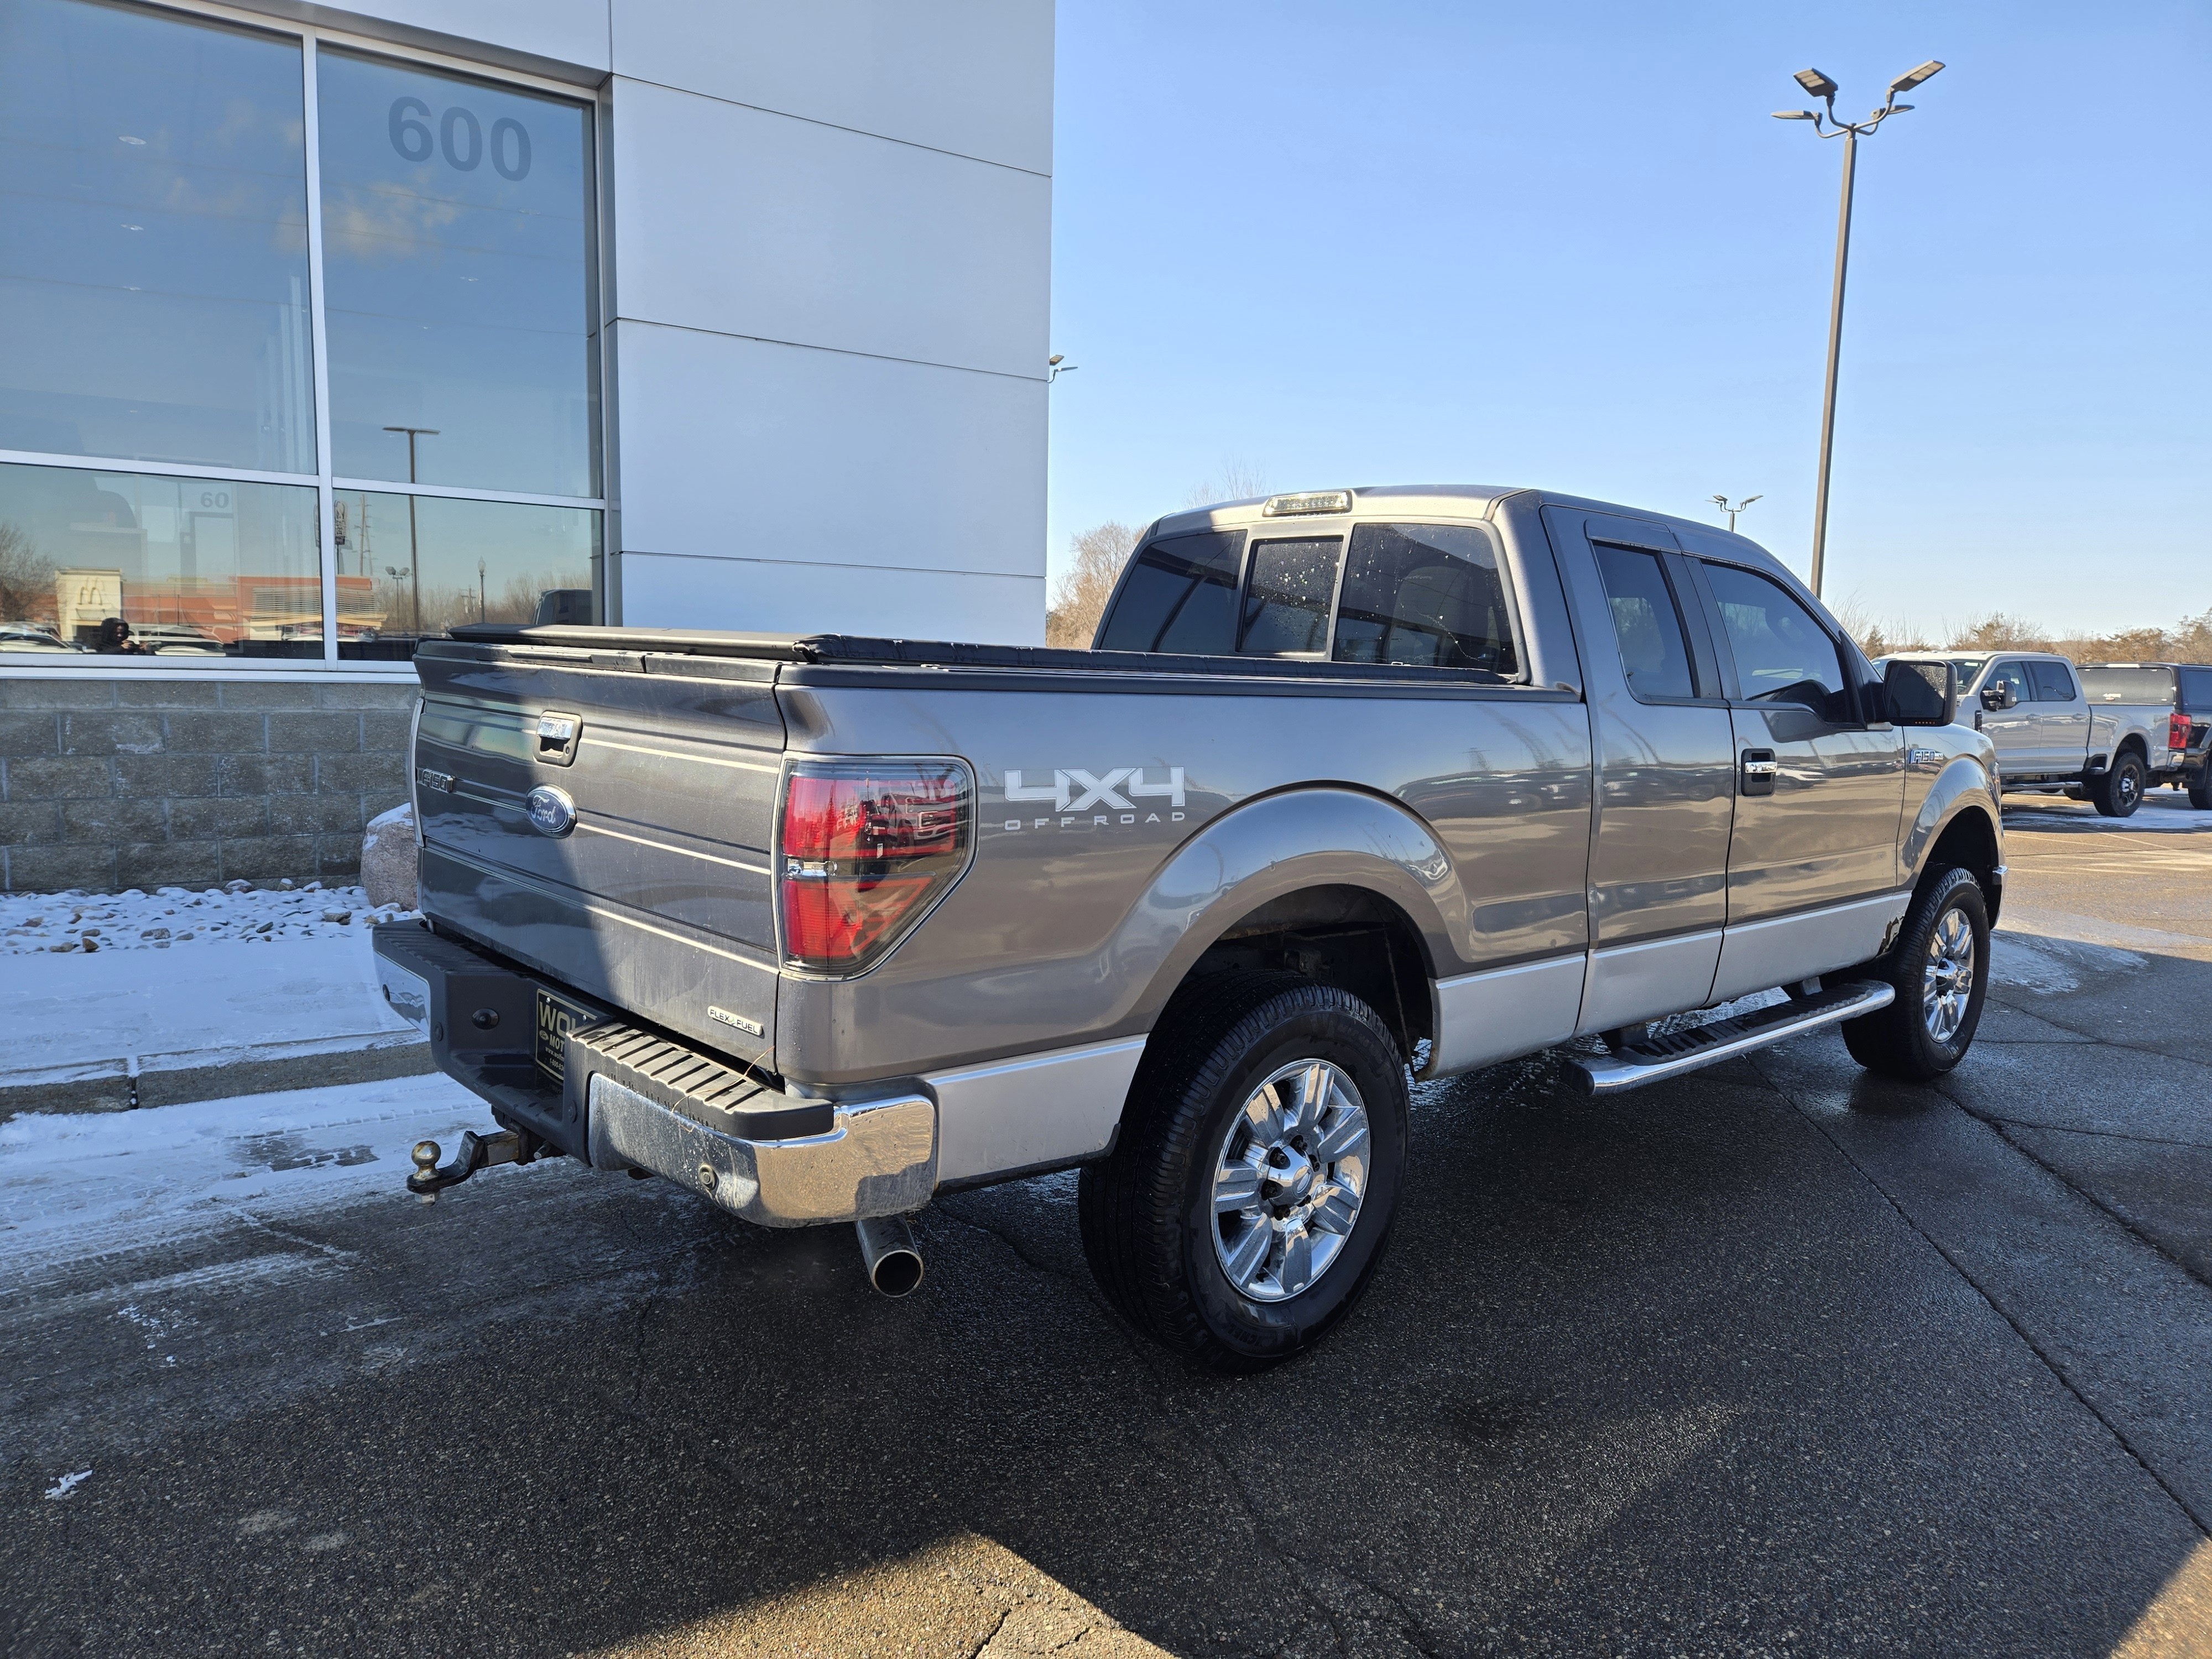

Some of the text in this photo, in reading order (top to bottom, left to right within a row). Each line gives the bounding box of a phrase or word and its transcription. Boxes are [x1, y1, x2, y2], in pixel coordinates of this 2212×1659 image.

[388, 96, 531, 181] 600
[531, 795, 556, 823] Ford
[1004, 812, 1185, 830] OFF ROAD
[710, 1009, 758, 1034] FLEX FUEL
